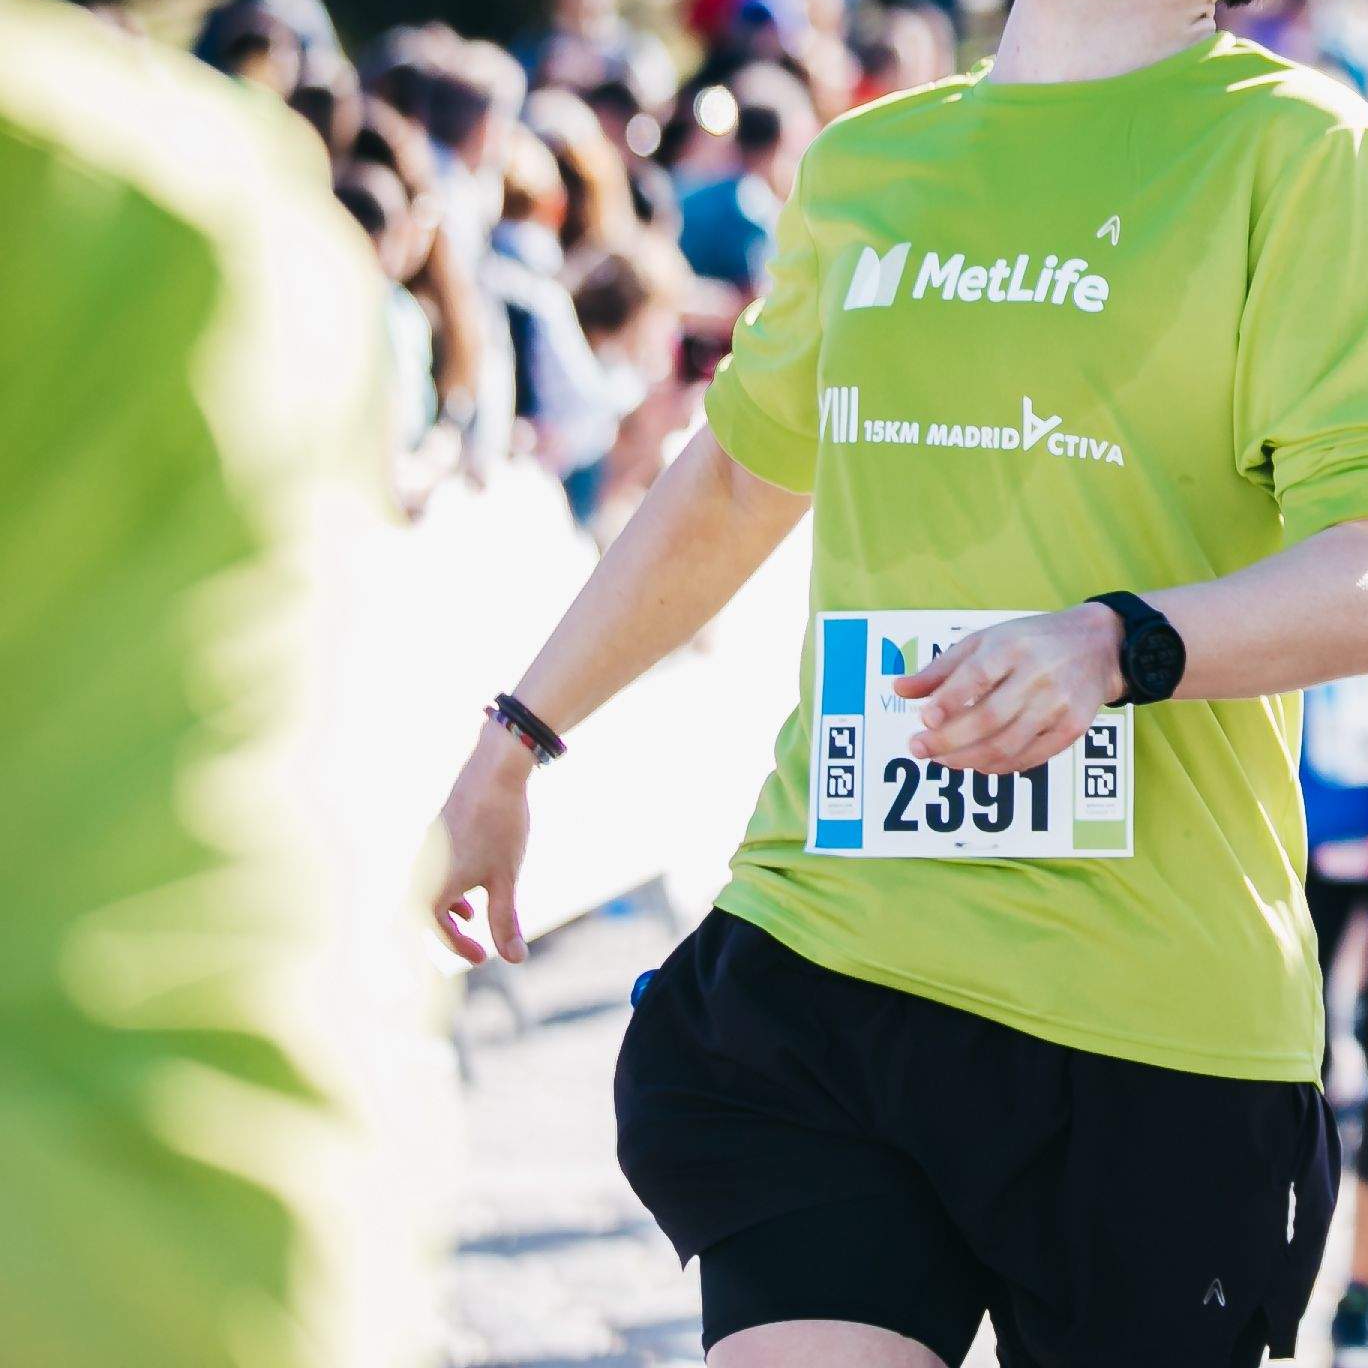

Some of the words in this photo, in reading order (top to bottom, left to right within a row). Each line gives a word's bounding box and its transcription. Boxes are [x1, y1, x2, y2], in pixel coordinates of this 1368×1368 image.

[912, 251, 1110, 312] MetLife
[863, 419, 919, 444] 15KM
[926, 423, 1021, 450] MADRID
[883, 757, 1049, 832] 2391
